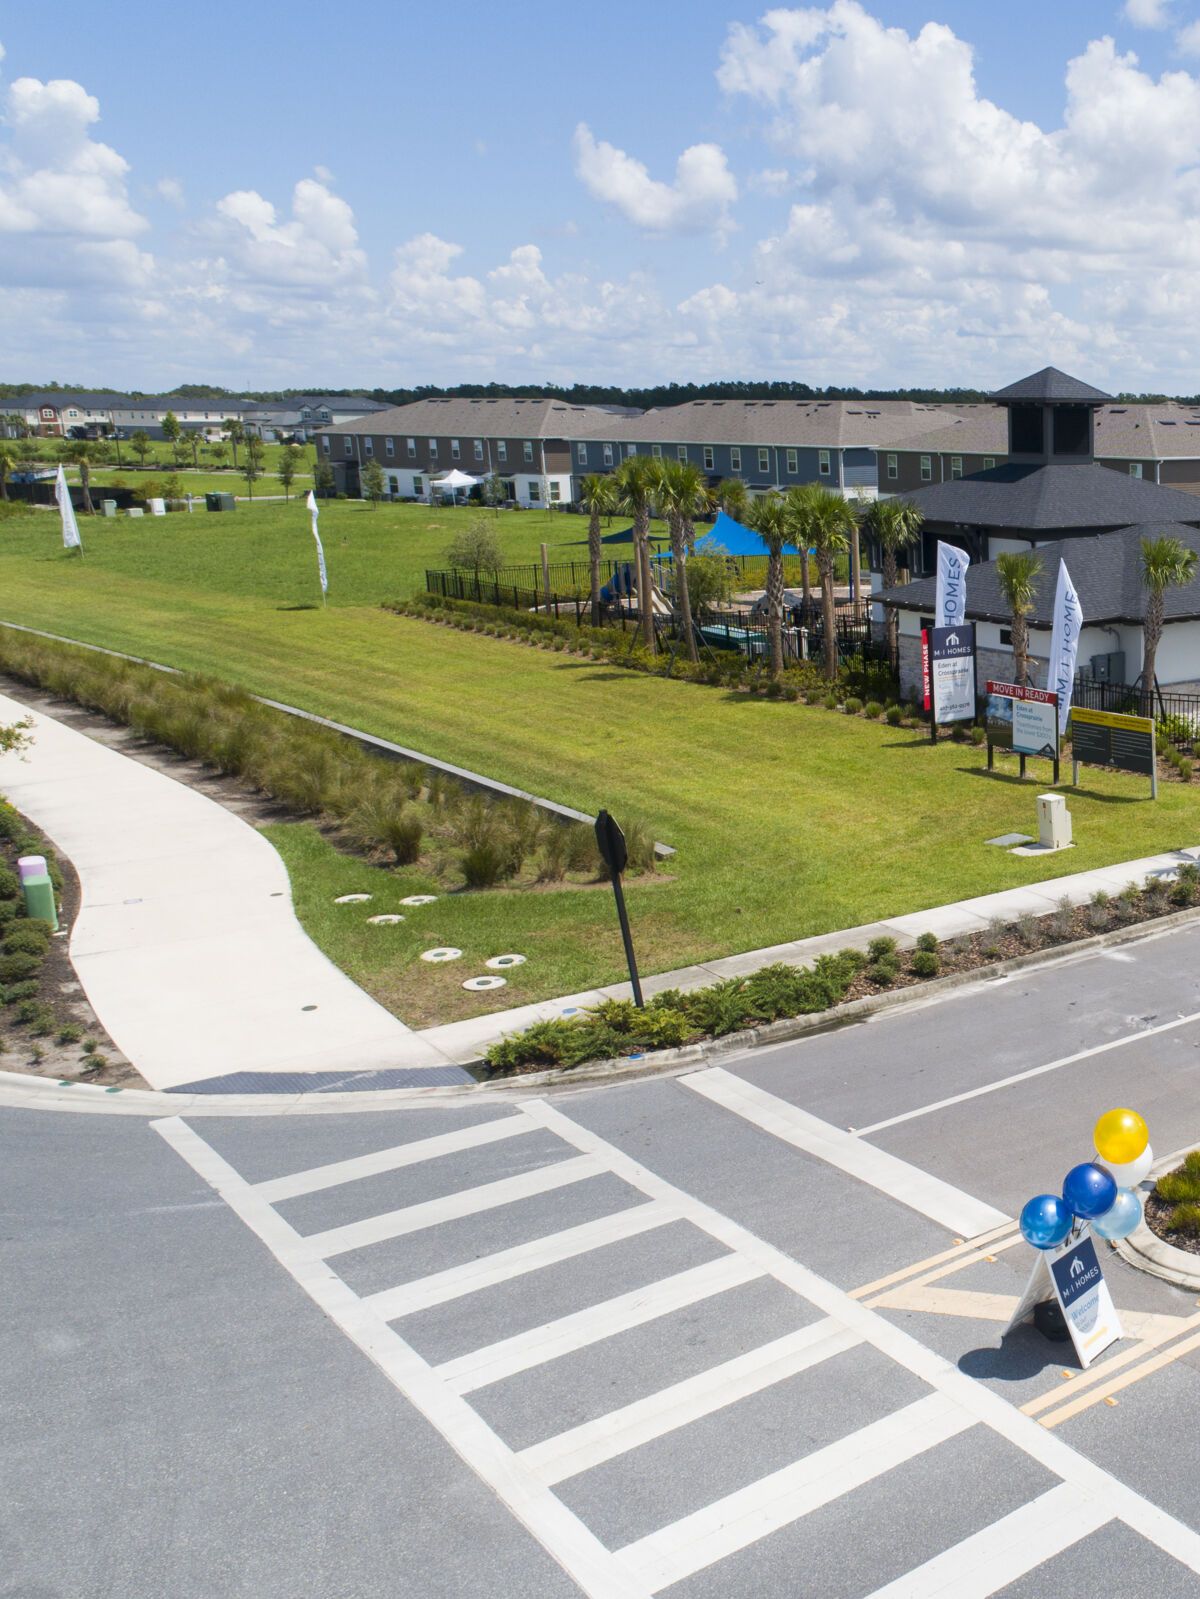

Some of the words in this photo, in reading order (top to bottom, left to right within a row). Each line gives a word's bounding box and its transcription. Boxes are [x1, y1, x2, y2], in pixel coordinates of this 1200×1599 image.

[943, 556, 962, 627] HOMES
[922, 643, 930, 673] PHASE
[947, 646, 971, 655] HOMES
[923, 675, 931, 696] NEW
[1055, 660, 1068, 696] M/I
[992, 684, 1014, 696] MOVE
[1015, 688, 1024, 698] IN
[1025, 690, 1050, 702] READY
[1075, 1266, 1099, 1288] HOMES
